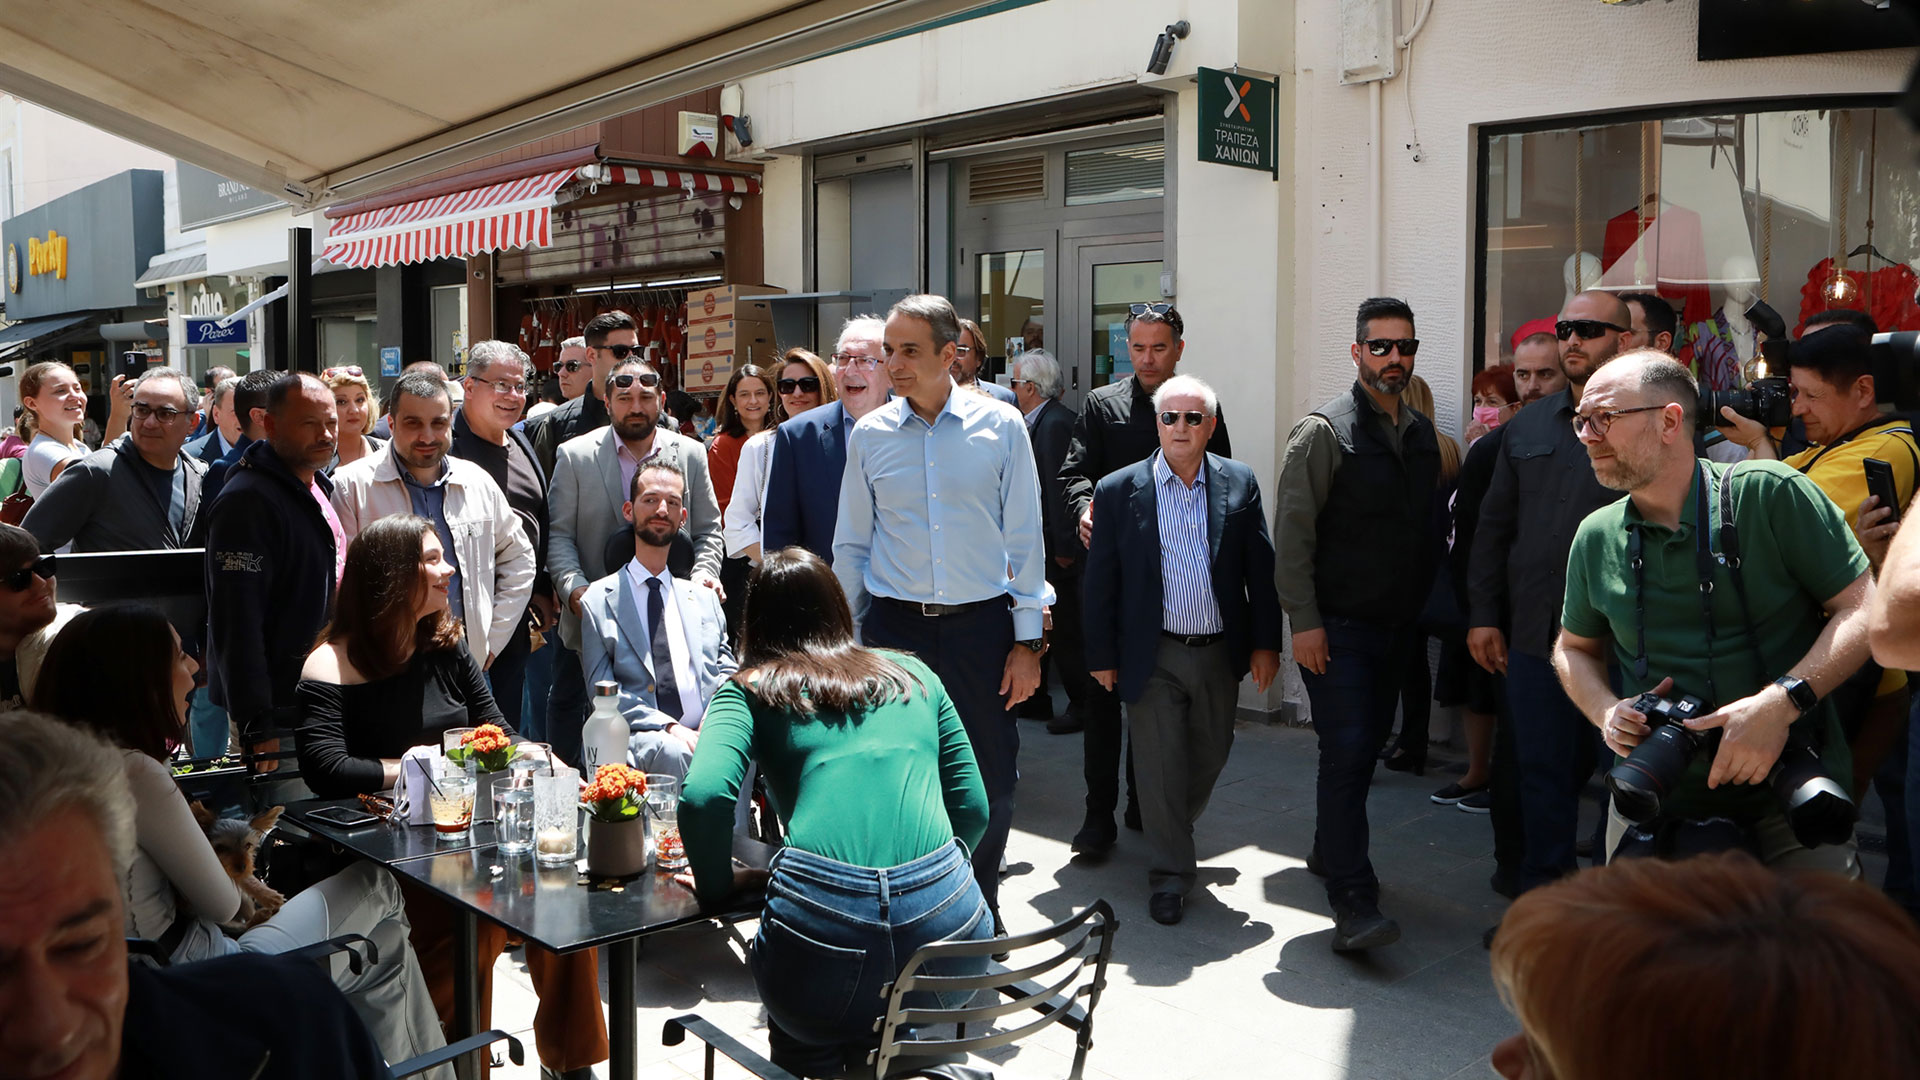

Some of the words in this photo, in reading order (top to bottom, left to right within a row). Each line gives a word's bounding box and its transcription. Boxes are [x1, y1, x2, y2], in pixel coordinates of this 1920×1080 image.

[1214, 128, 1259, 148] ΤΡΑΠΕΖΑ
[1215, 144, 1259, 165] ΧΑΝΙΩΝ
[28, 230, 67, 280] Porky
[199, 322, 235, 343] Parex
